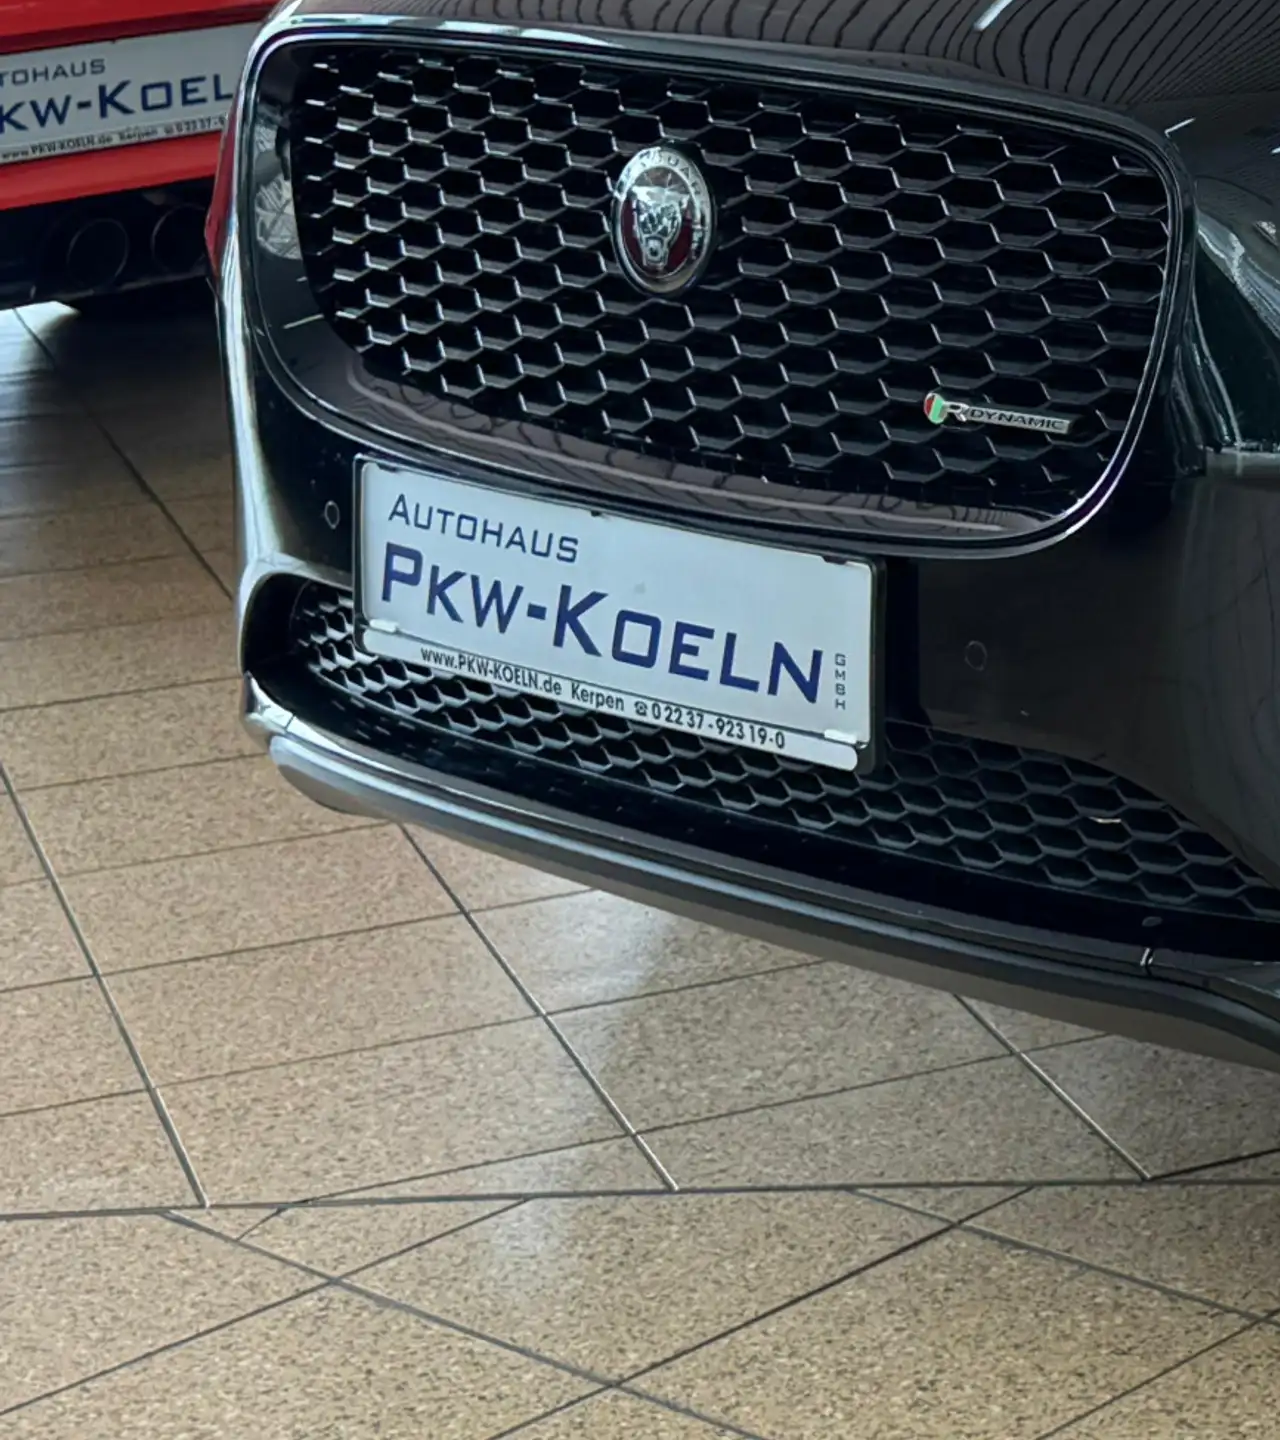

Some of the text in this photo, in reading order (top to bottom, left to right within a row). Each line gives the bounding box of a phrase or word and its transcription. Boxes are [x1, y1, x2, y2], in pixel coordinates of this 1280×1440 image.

[970, 408, 1065, 431] DYNAMIC
[388, 493, 579, 563] AUTOHAUS
[381, 542, 823, 704] PKW-KOELN
[420, 647, 562, 696] www.PKW-KOELN.de
[571, 682, 625, 712] Kerpen
